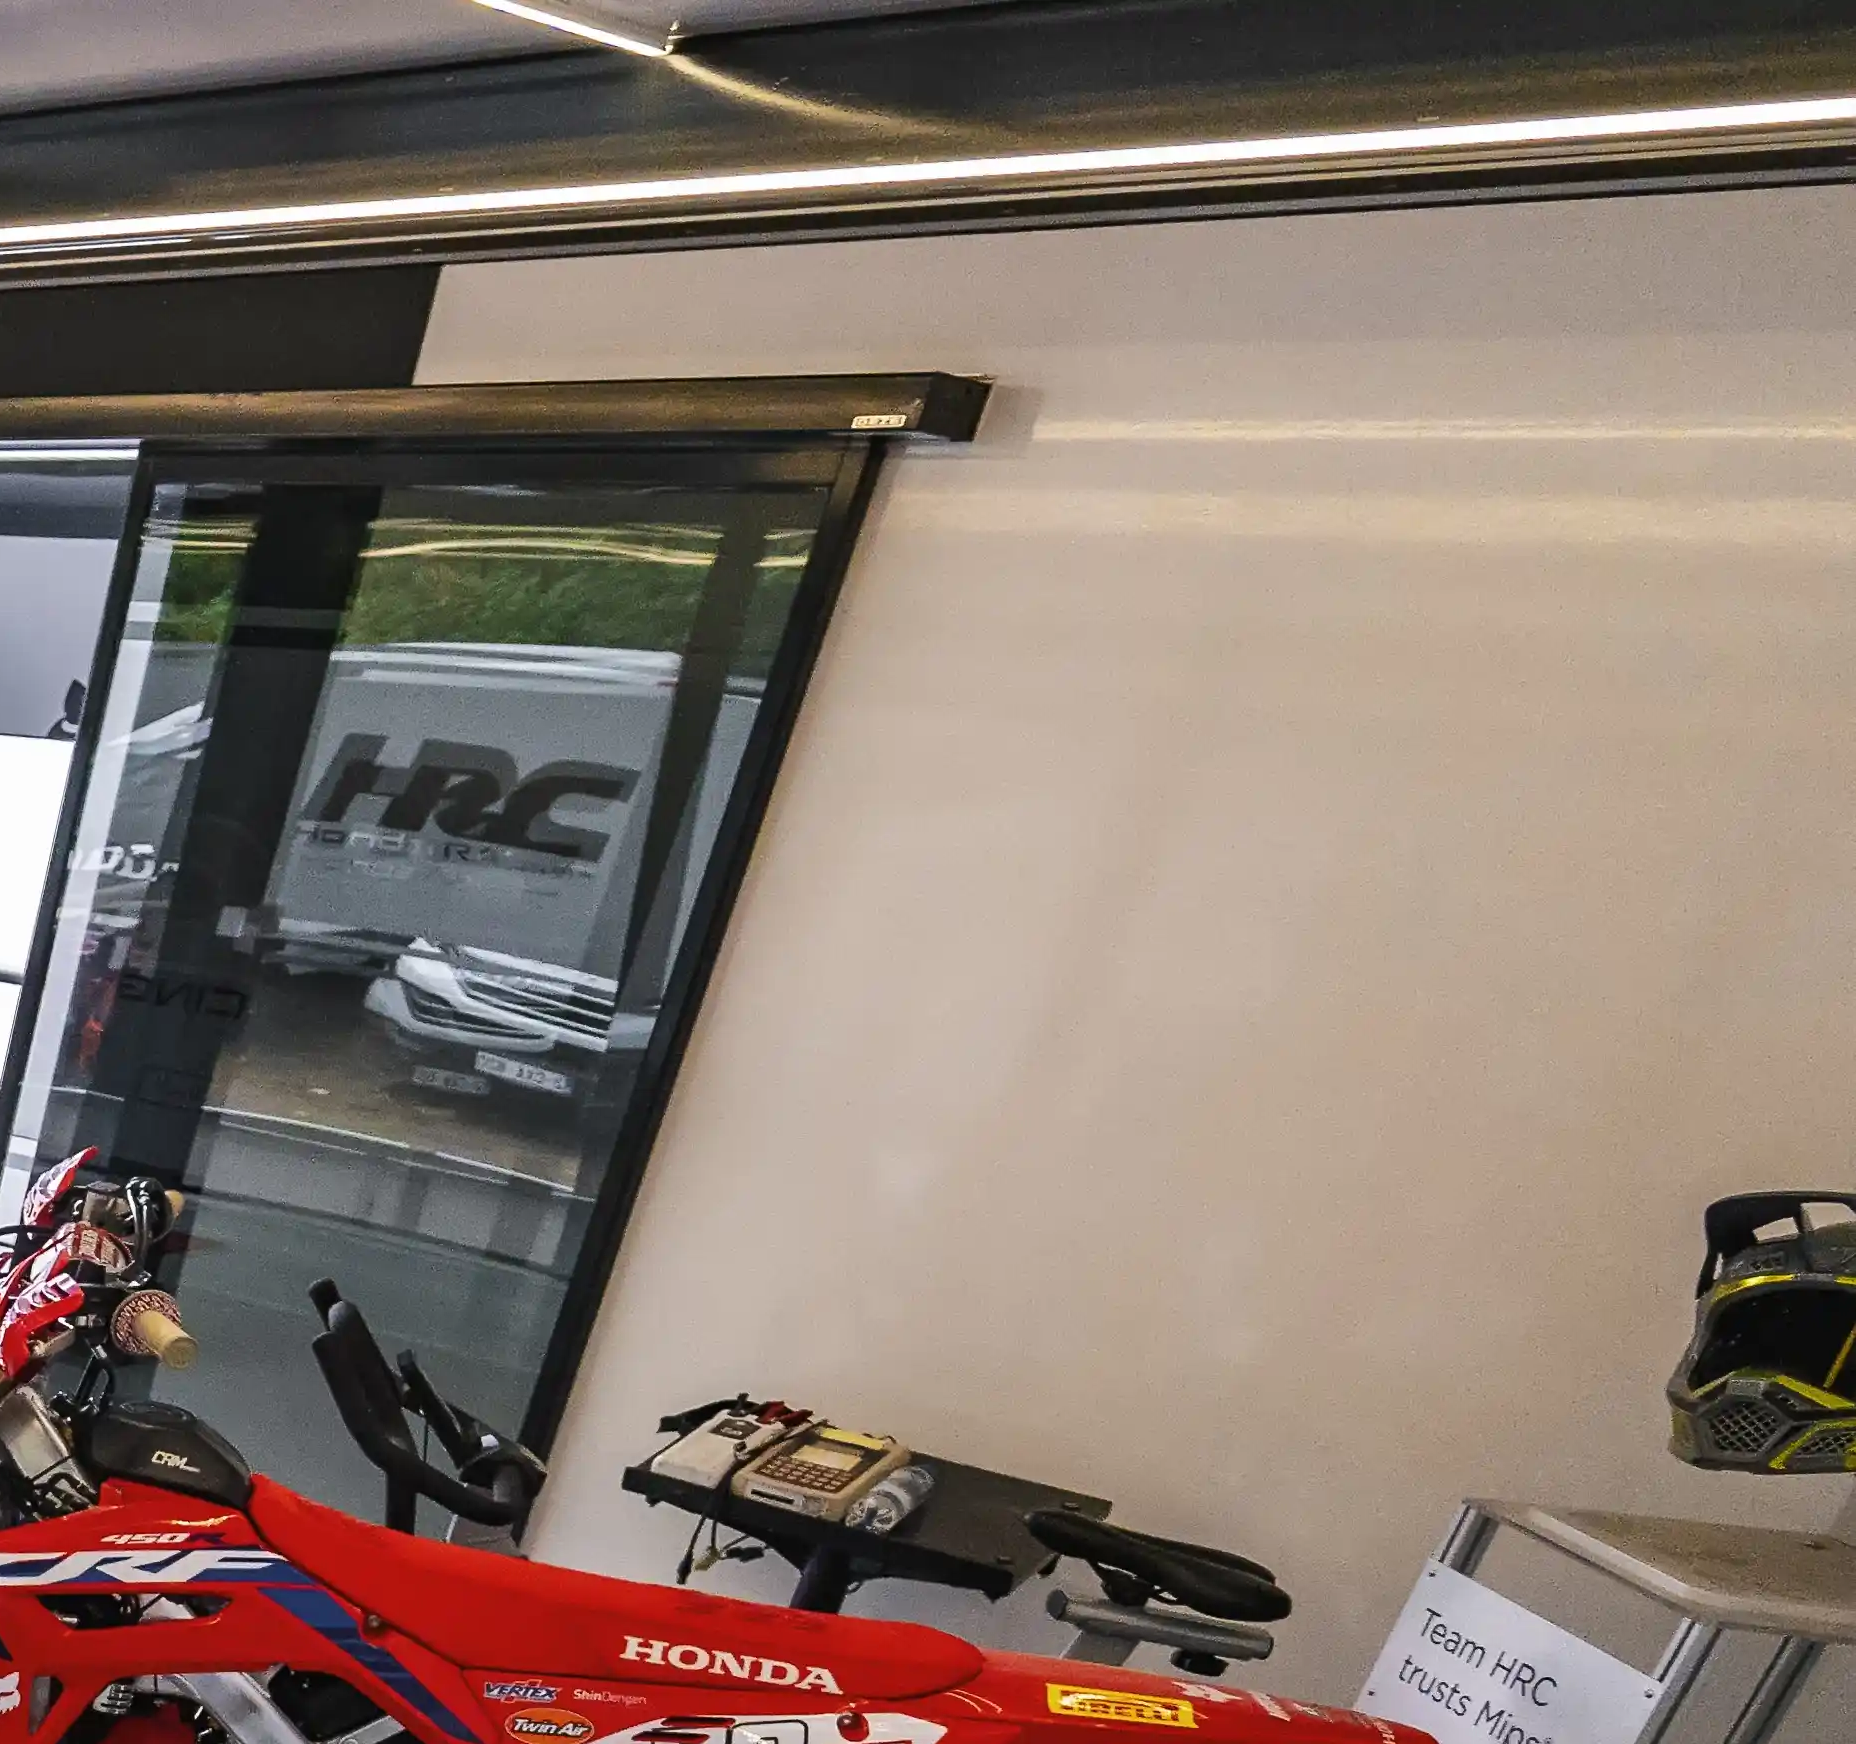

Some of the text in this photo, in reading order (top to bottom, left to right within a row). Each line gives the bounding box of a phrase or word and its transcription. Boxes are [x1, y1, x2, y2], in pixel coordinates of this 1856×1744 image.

[619, 1636, 843, 1695] HONDA
[1399, 1657, 1470, 1717] trusts
[1418, 1608, 1558, 1708] Team HRC
[484, 1682, 558, 1702] VERTEX
[511, 1717, 589, 1736] Twin Air
